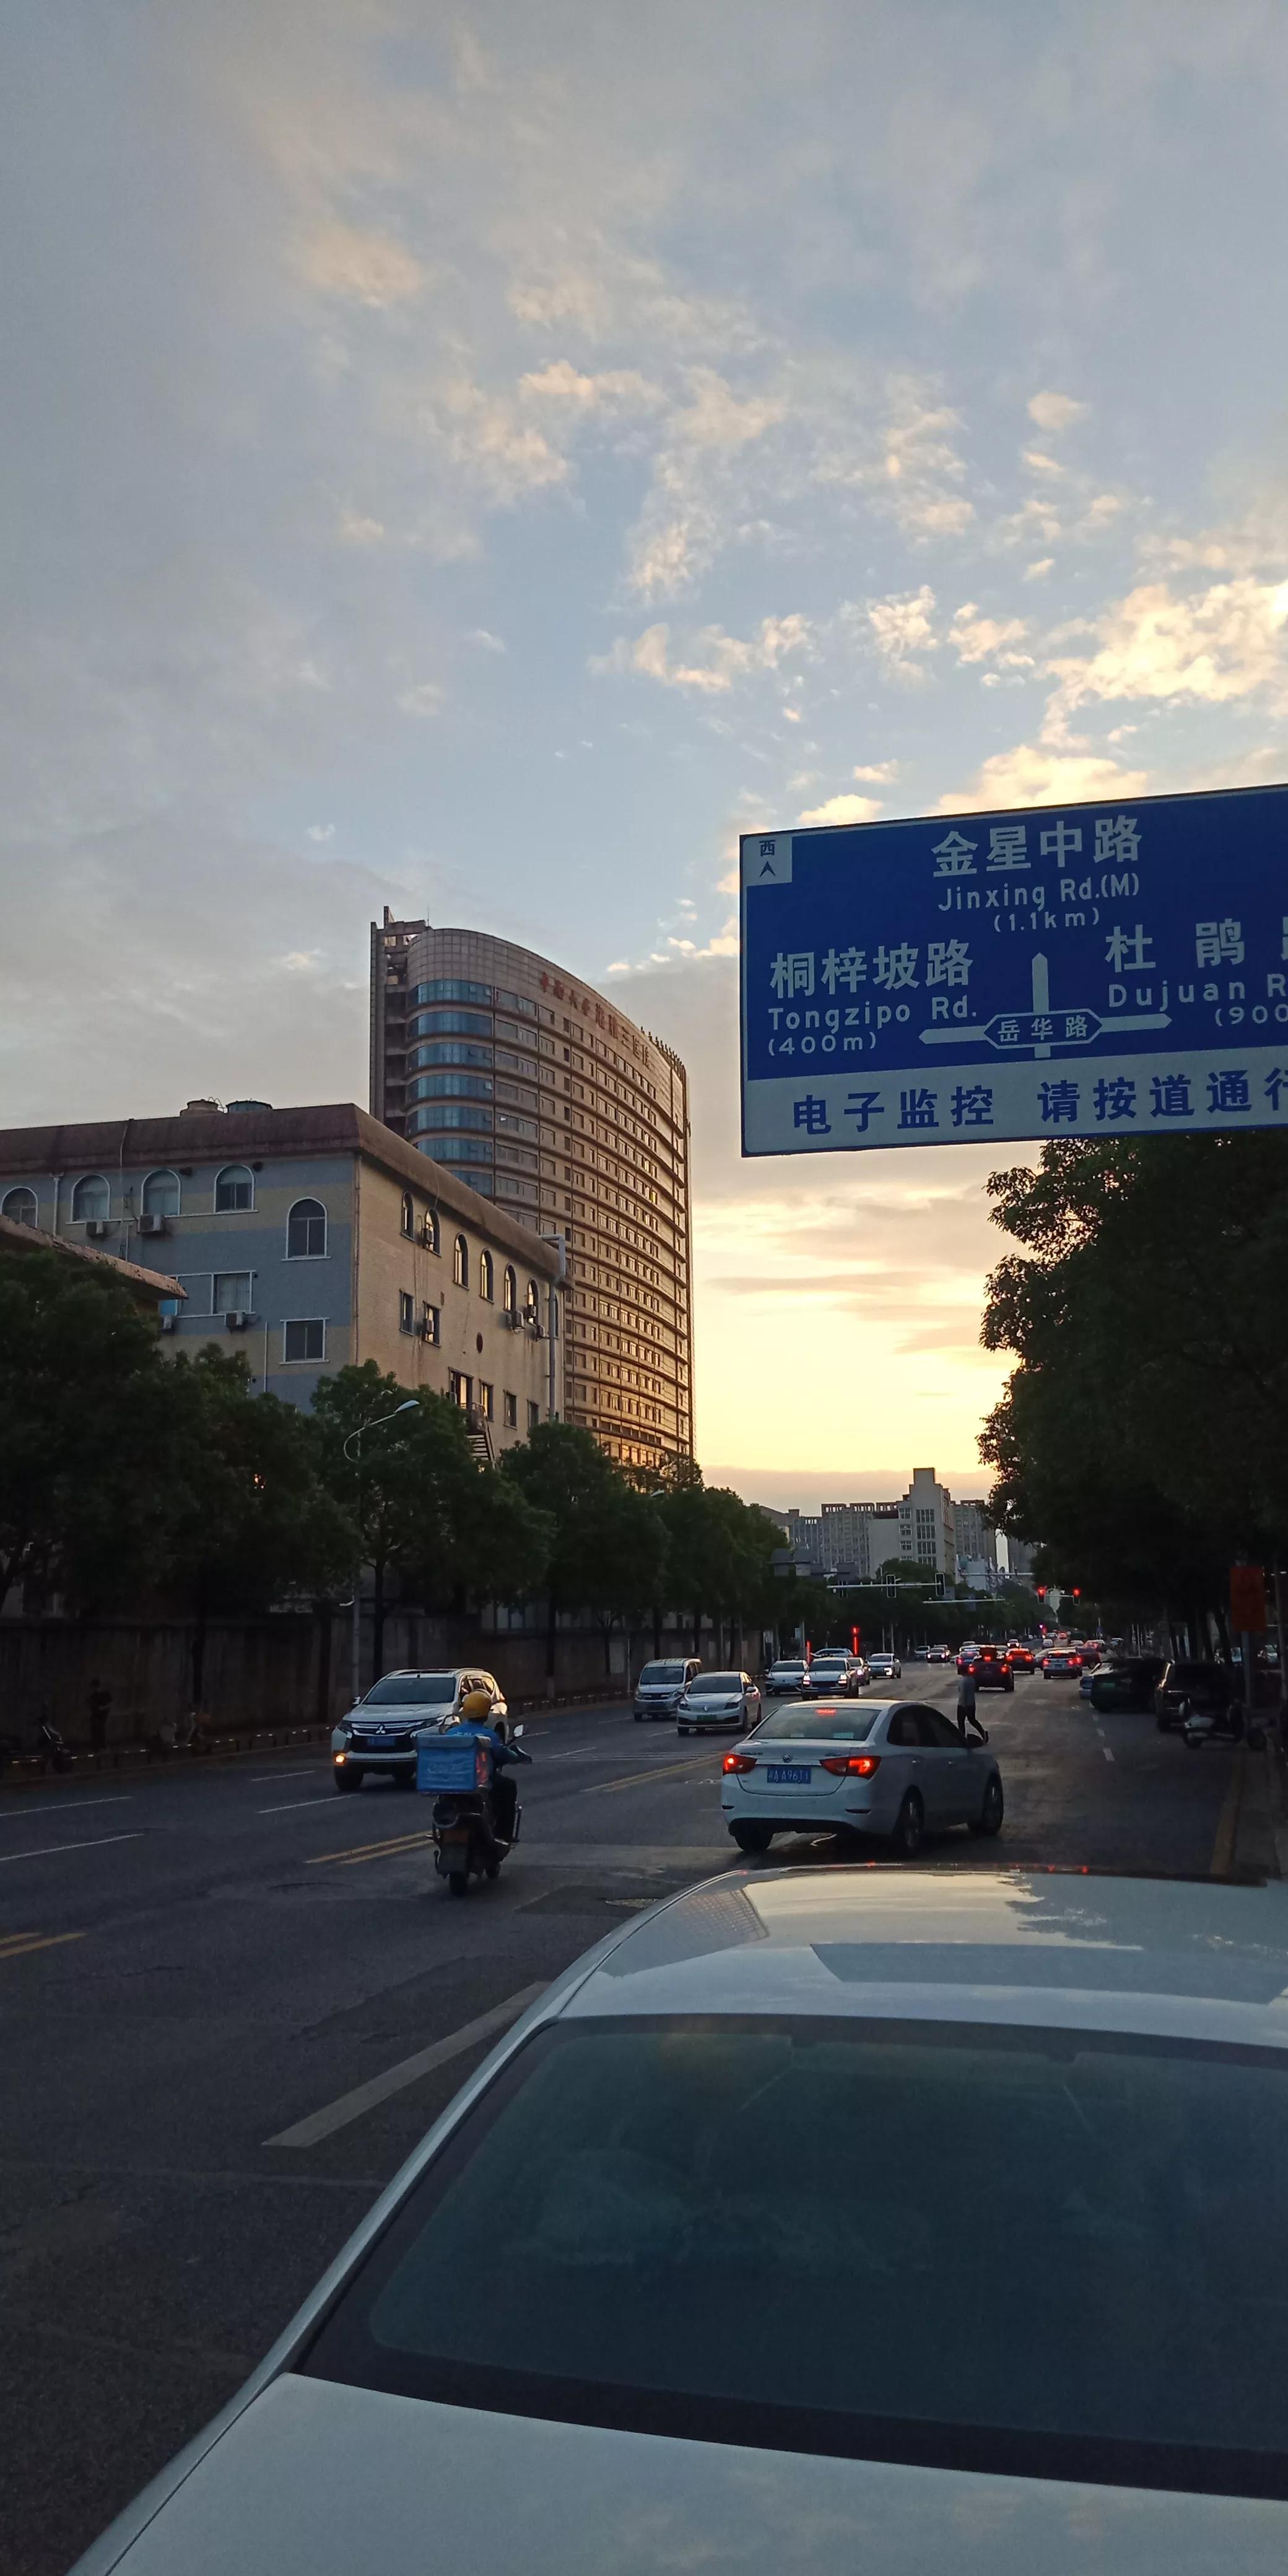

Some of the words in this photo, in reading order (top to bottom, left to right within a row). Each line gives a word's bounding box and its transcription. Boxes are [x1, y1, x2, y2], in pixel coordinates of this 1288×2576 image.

[759, 839, 777, 857] 西
[931, 815, 1142, 877] 金星中路
[938, 883, 1045, 912] Jinxing
[1060, 873, 1139, 902] Rd.(M)
[994, 907, 1099, 933] (1.1km)
[1105, 916, 1288, 972] 杜鹃
[770, 939, 973, 999] 桐梓坡路
[768, 1001, 911, 1034] Tongzipo
[931, 994, 977, 1020] Rd.
[1108, 980, 1245, 1012] Dujuan
[768, 1032, 876, 1056] (400m)
[998, 1015, 1088, 1042] 岳华路
[793, 1085, 994, 1134] 电子监控
